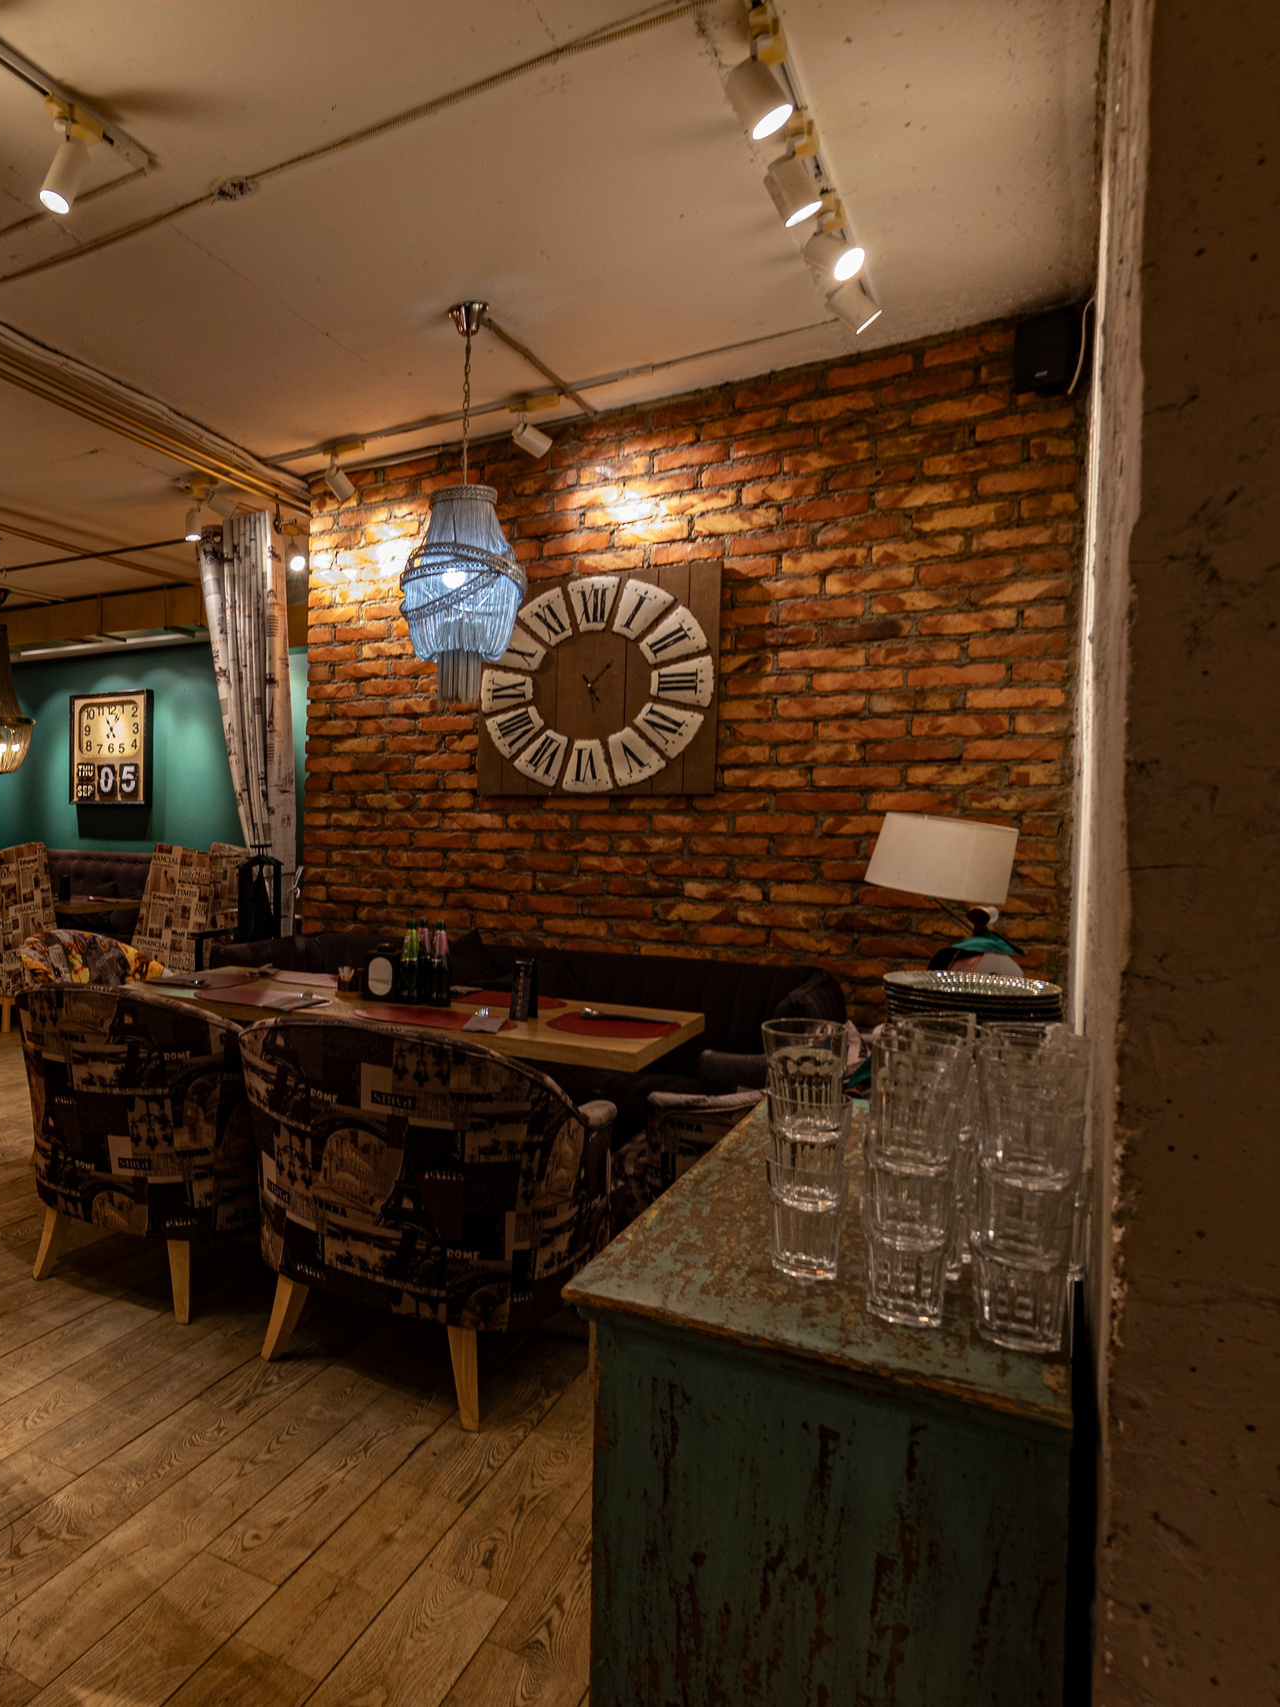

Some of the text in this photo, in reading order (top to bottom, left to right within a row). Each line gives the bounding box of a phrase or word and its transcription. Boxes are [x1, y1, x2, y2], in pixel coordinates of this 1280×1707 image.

[657, 668, 698, 695] III
[85, 708, 95, 720] 10
[97, 705, 105, 716] 11
[107, 704, 117, 715] 12
[120, 703, 125, 714] 1
[131, 705, 139, 718] 2
[84, 725, 91, 736] 9
[132, 722, 139, 735] 3
[85, 740, 92, 752] 8
[96, 743, 103, 754] 7
[107, 743, 114, 753] 6
[118, 743, 125, 753] 5
[131, 738, 138, 750] 4
[77, 764, 94, 778] THU
[77, 784, 94, 798] SEP
[177, 889, 197, 898] TIMES
[310, 1087, 338, 1102] ROME
[447, 1248, 480, 1260] ROME
